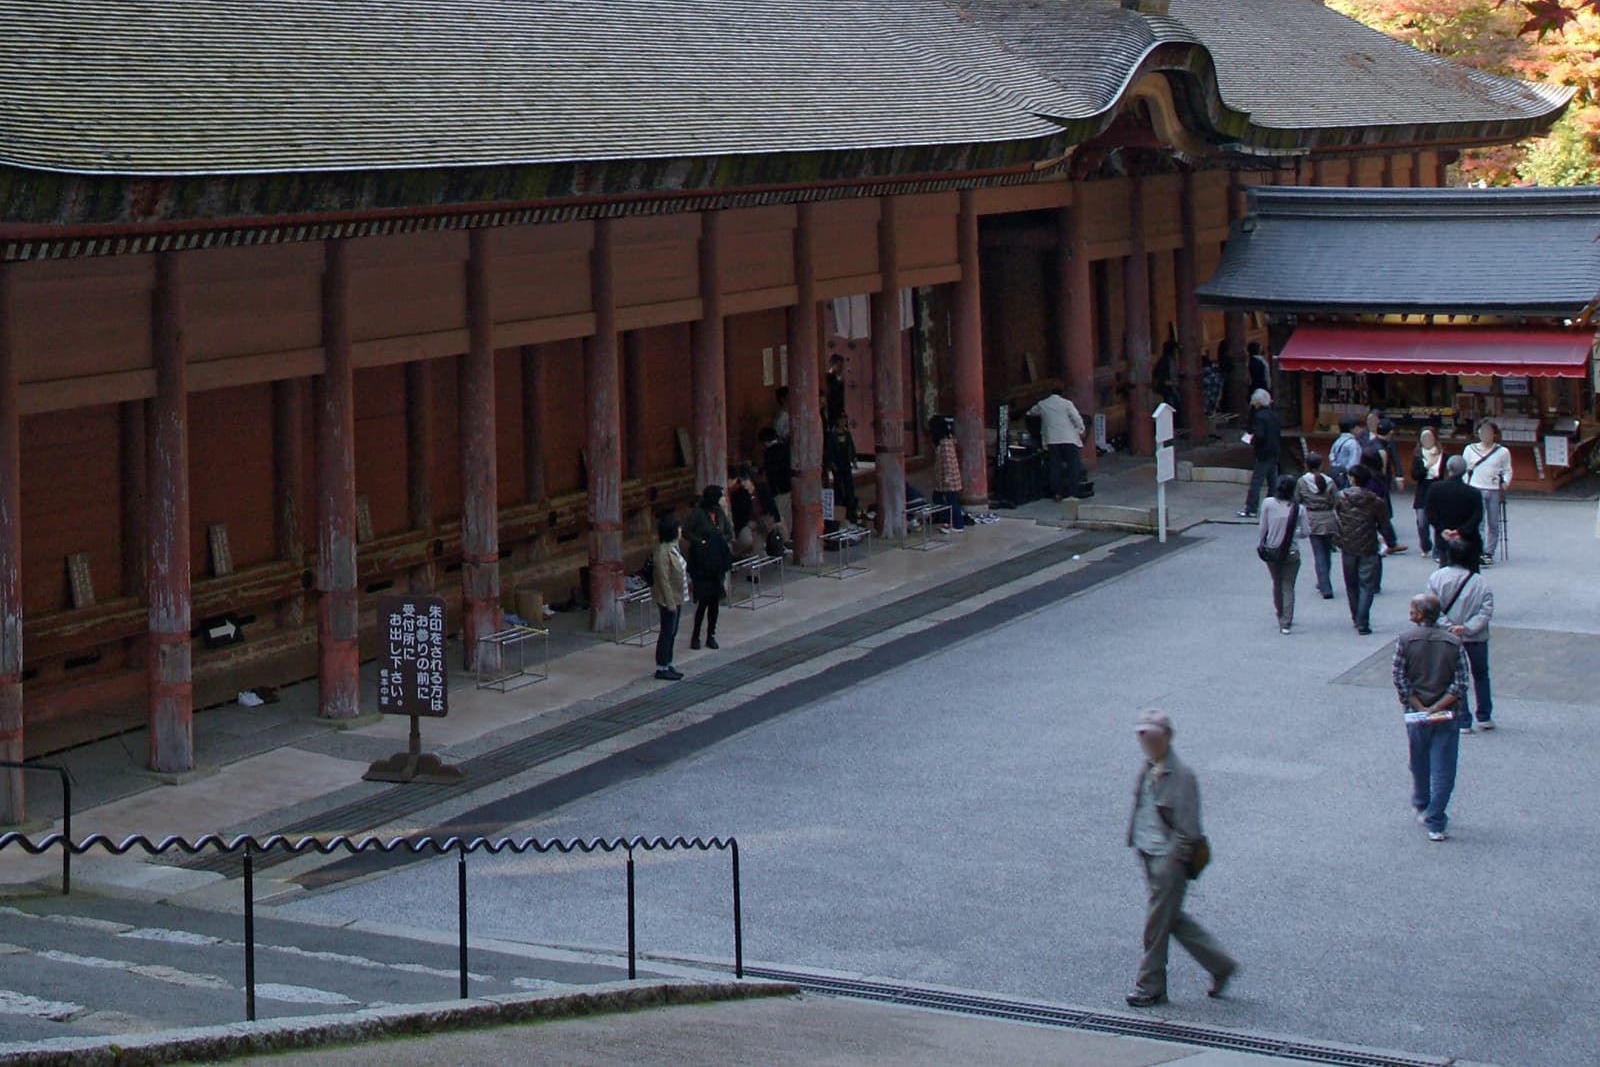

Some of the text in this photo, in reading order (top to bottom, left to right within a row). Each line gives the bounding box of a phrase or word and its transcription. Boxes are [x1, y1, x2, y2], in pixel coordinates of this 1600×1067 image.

[390, 613, 403, 706] お出し下さい。
[402, 603, 415, 660] 受付所に
[416, 615, 429, 699] お参りの前に
[429, 605, 443, 711] 朱印をされる方は
